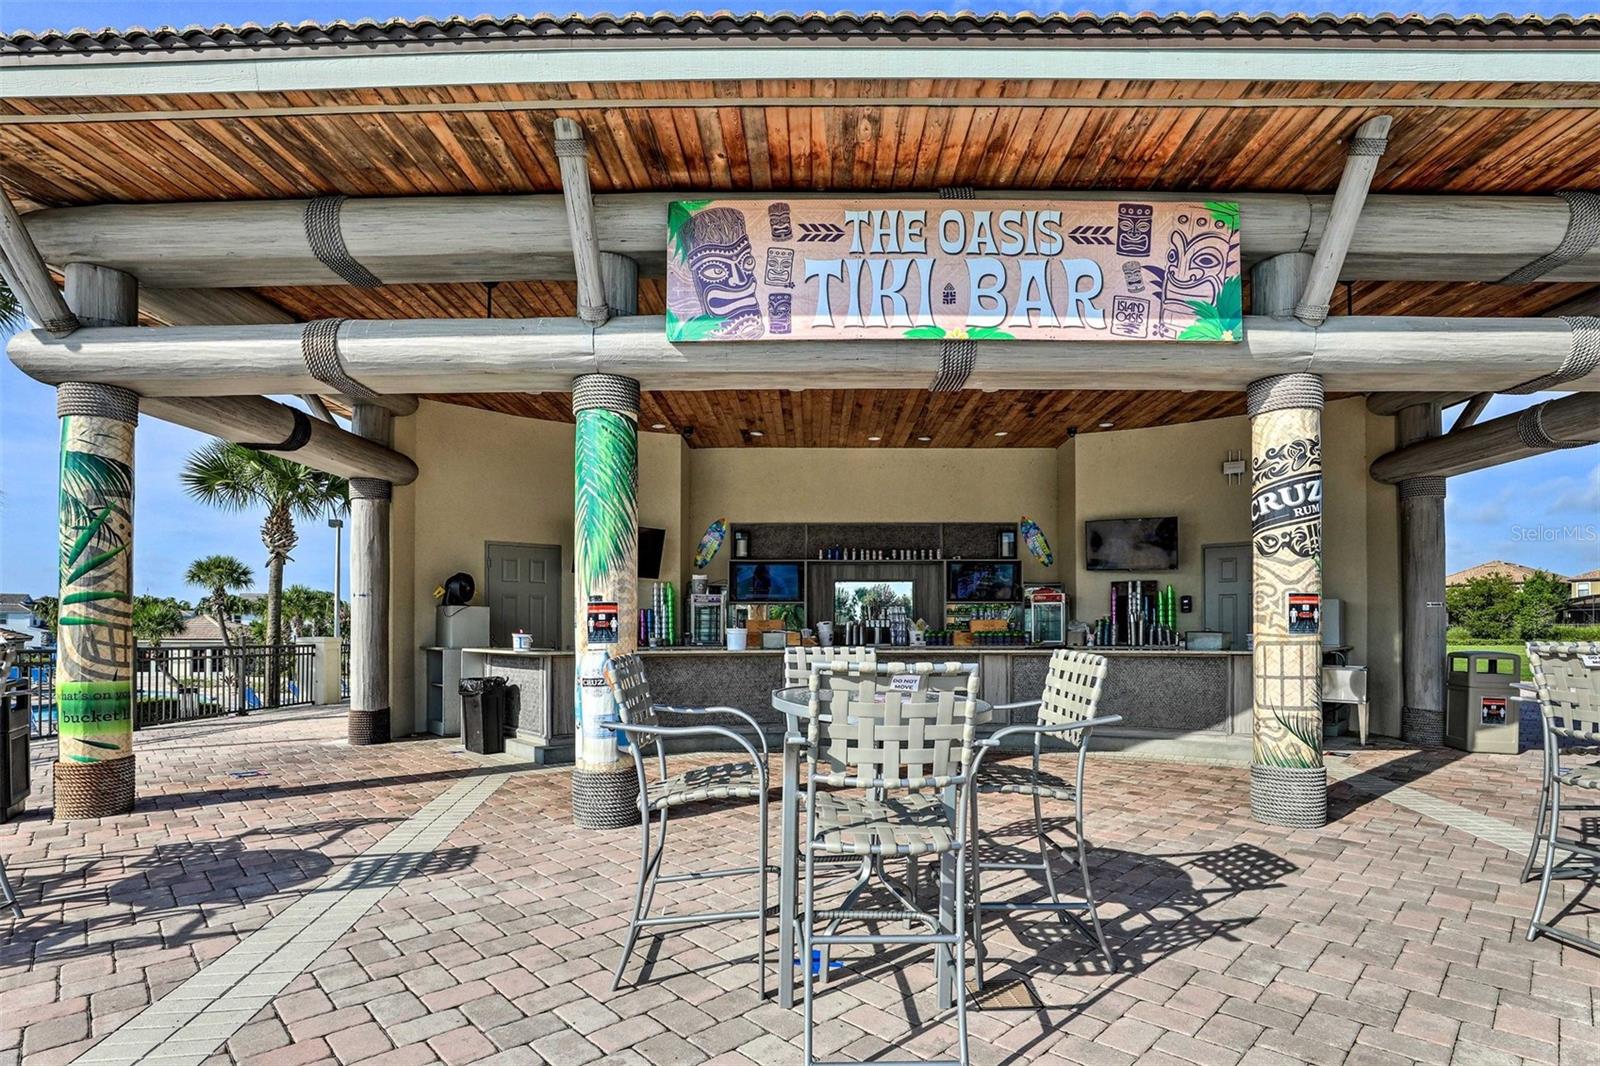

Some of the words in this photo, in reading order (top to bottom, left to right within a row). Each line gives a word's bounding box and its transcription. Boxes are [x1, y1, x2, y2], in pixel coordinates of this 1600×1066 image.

[844, 209, 928, 255] THE
[938, 209, 1065, 257] OASIS
[804, 257, 937, 328] TIKI
[964, 256, 1107, 330] BAR
[1117, 300, 1145, 313] ISLAND
[1115, 311, 1144, 324] OASIS
[1293, 504, 1320, 517] RUM
[92, 691, 113, 701] on
[63, 710, 120, 723] bucket
